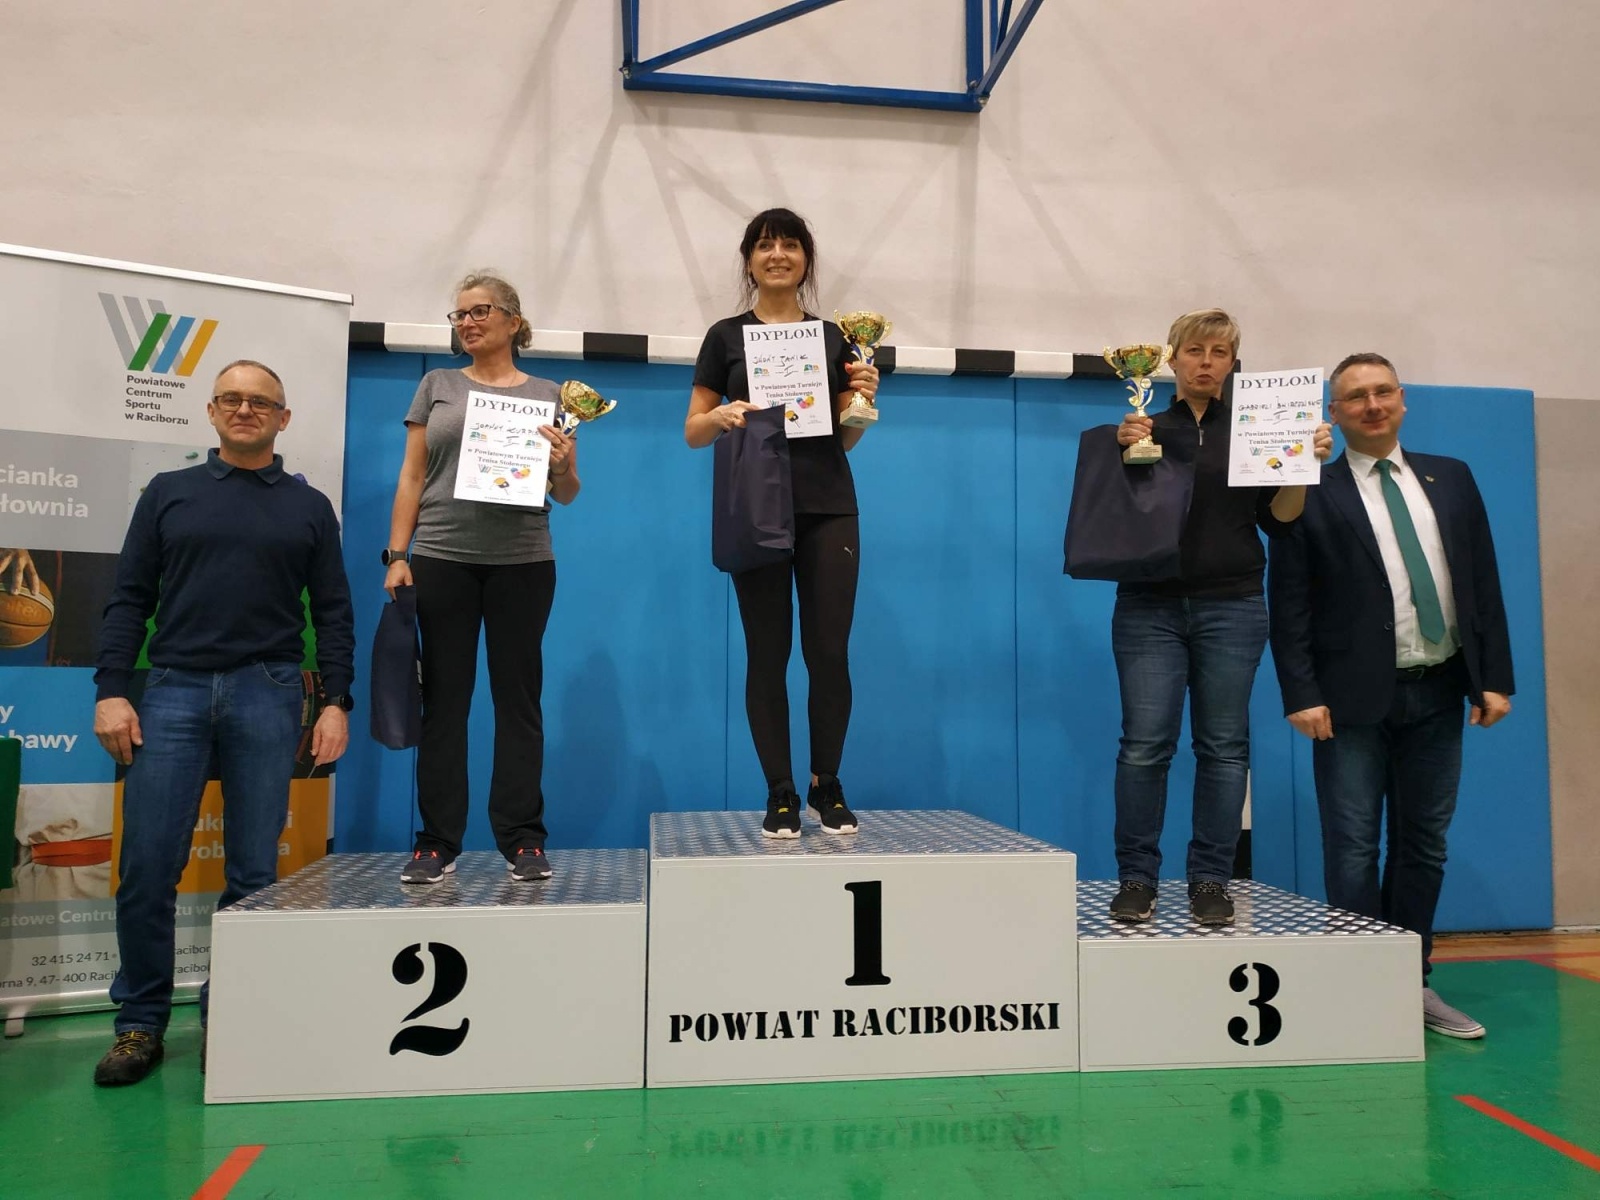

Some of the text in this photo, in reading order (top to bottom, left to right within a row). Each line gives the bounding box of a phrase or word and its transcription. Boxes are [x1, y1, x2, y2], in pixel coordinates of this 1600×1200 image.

[749, 328, 818, 341] DYPLOM
[126, 375, 186, 389] Powiatowe
[1240, 374, 1317, 389] DYPLOM
[125, 387, 173, 400] Centrum
[125, 399, 161, 411] Sportu
[474, 398, 548, 417] DYPLOM
[125, 412, 189, 425] w Raciborzu
[845, 881, 891, 986] 1
[31, 956, 47, 967] 32
[49, 954, 74, 965] 415
[76, 952, 92, 963] 24
[95, 951, 110, 962] 71
[62, 972, 87, 983] 400
[390, 942, 470, 1056] 2
[1228, 963, 1281, 1046] 3
[669, 1002, 1060, 1043] POWIAT RACIBORSKI
